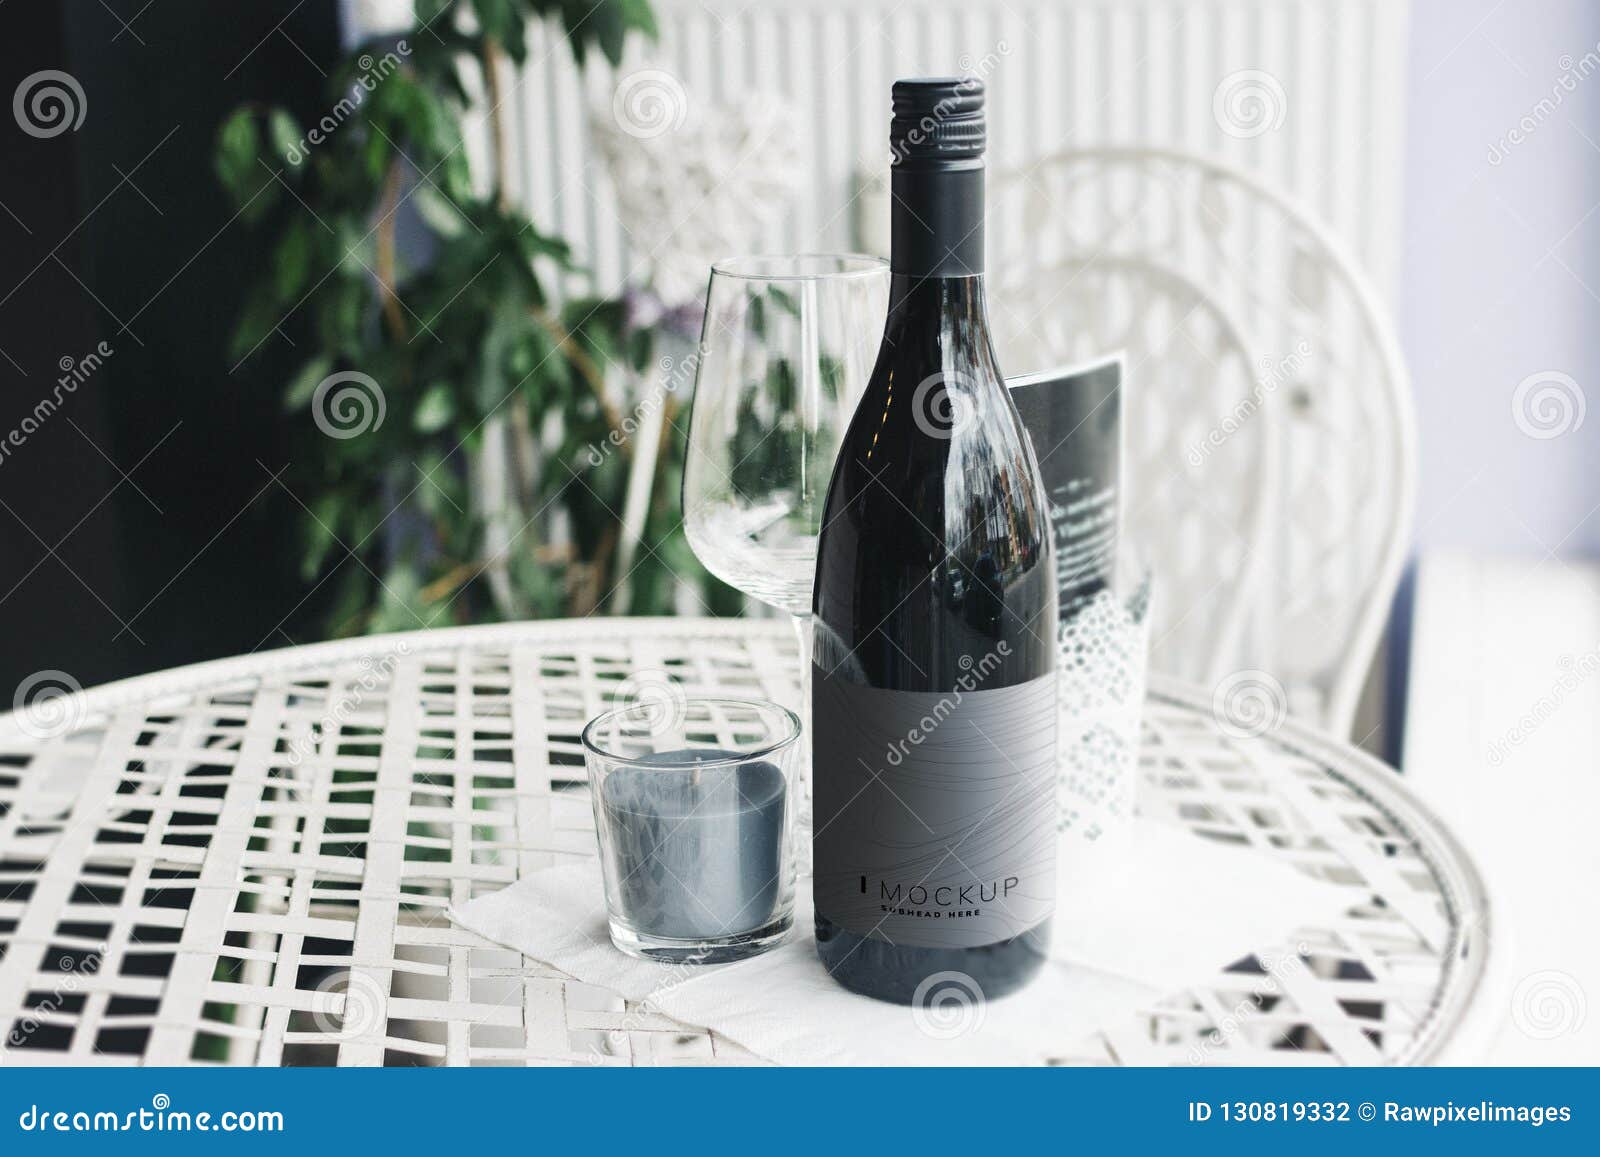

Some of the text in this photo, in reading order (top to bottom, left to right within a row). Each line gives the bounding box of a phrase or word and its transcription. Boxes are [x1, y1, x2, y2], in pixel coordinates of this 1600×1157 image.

[880, 876, 1020, 907] MOCKUP
[880, 904, 981, 919] SUBHEAD HERE
